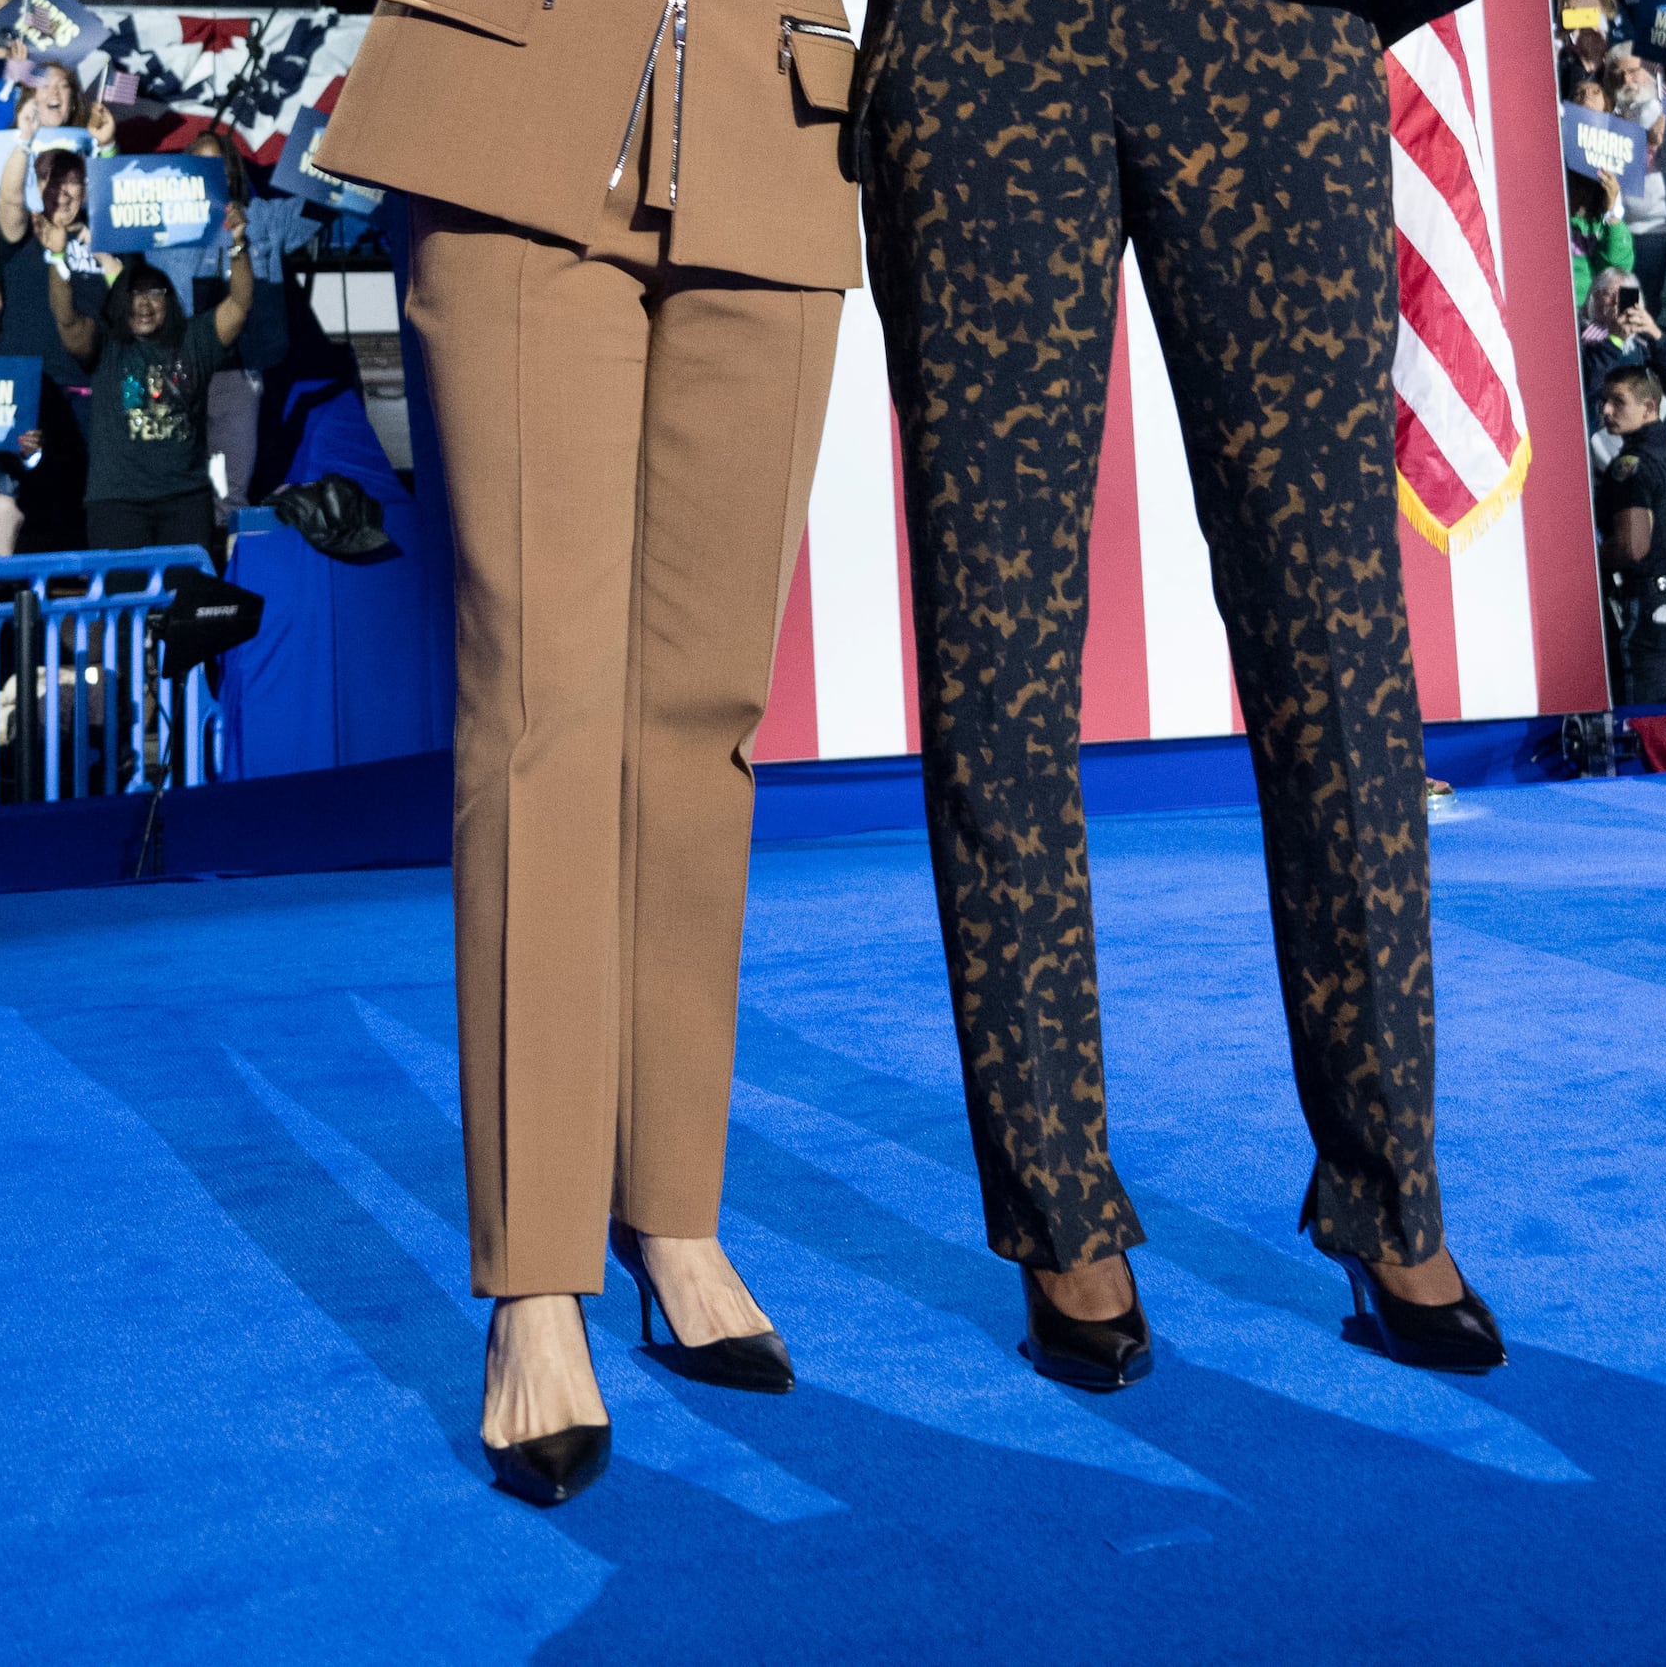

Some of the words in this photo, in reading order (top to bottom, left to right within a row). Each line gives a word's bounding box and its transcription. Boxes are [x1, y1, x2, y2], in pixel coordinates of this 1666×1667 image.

[1577, 122, 1634, 163] HARRIS
[1584, 148, 1624, 176] WALZ
[112, 176, 205, 204] MICHIGAN
[109, 202, 160, 228] VOTES
[162, 199, 212, 225] EARLY
